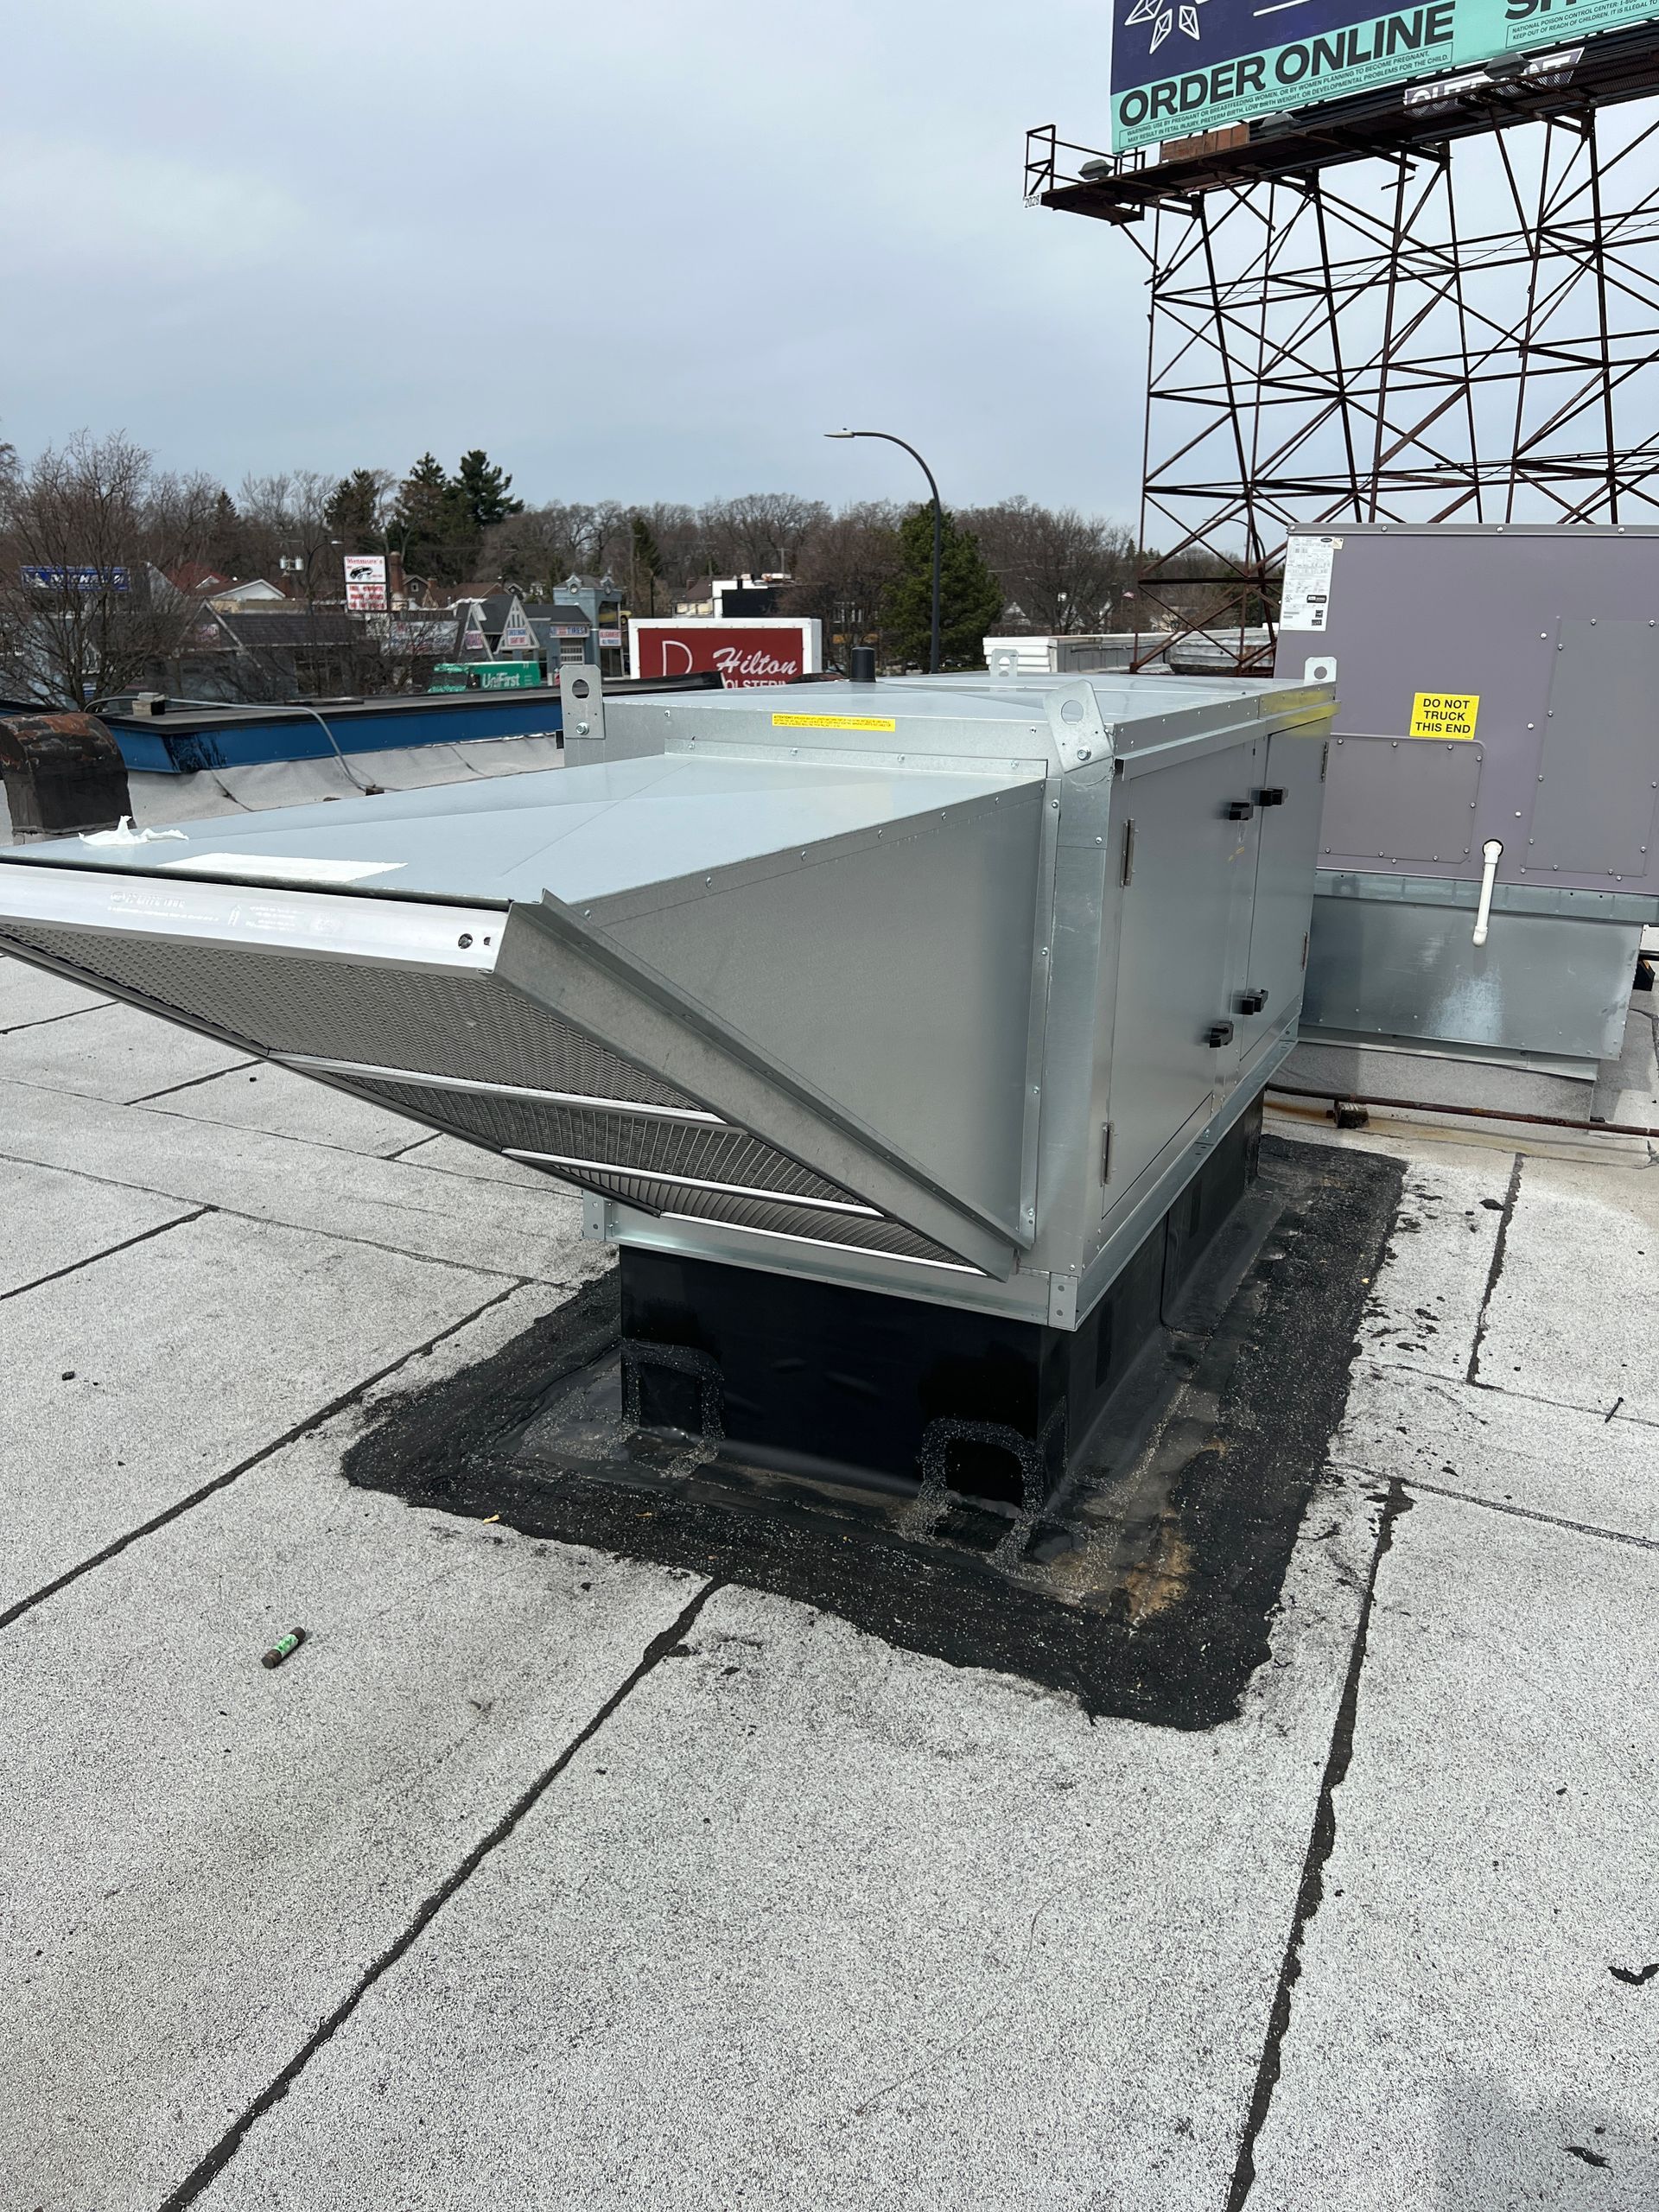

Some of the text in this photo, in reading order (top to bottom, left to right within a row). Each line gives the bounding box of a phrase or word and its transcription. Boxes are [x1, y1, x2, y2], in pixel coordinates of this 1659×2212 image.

[1512, 22, 1540, 34] NATIONAL
[1541, 16, 1563, 26] POISON
[1564, 8, 1592, 20] CONTROL
[1593, 2, 1619, 12] CENTER:
[1548, 22, 1569, 31] REACH
[1579, 11, 1610, 23] CHILDREN.
[1624, 2, 1648, 12] ILLEGAL
[1120, 56, 1266, 127] ORDER
[1275, 2, 1455, 85] ONLINE
[1127, 125, 1152, 136] WARNING:
[1172, 113, 1199, 124] PREGNANT
[1210, 97, 1254, 115] BREASTFEEDING
[1299, 79, 1322, 90] WOMEN
[1323, 71, 1355, 84] PLANNING
[1365, 60, 1392, 73] BECOME
[1140, 130, 1158, 139] RESULT
[1165, 124, 1179, 133] FETAL
[1200, 112, 1226, 124] PRETERM
[1259, 99, 1276, 108] BIRTH
[1312, 77, 1363, 95] DEVELOPMENTAL
[1363, 66, 1398, 80] PROBLEMS
[1399, 63, 1413, 72] FOR
[1414, 59, 1427, 67] THE
[1427, 54, 1448, 65] CHILD.
[712, 646, 798, 676] Hilton
[482, 672, 520, 689] UniFirst
[1423, 698, 1470, 709] DO NOT
[1423, 710, 1465, 721] TRUCK
[1415, 721, 1471, 734] THIS END
